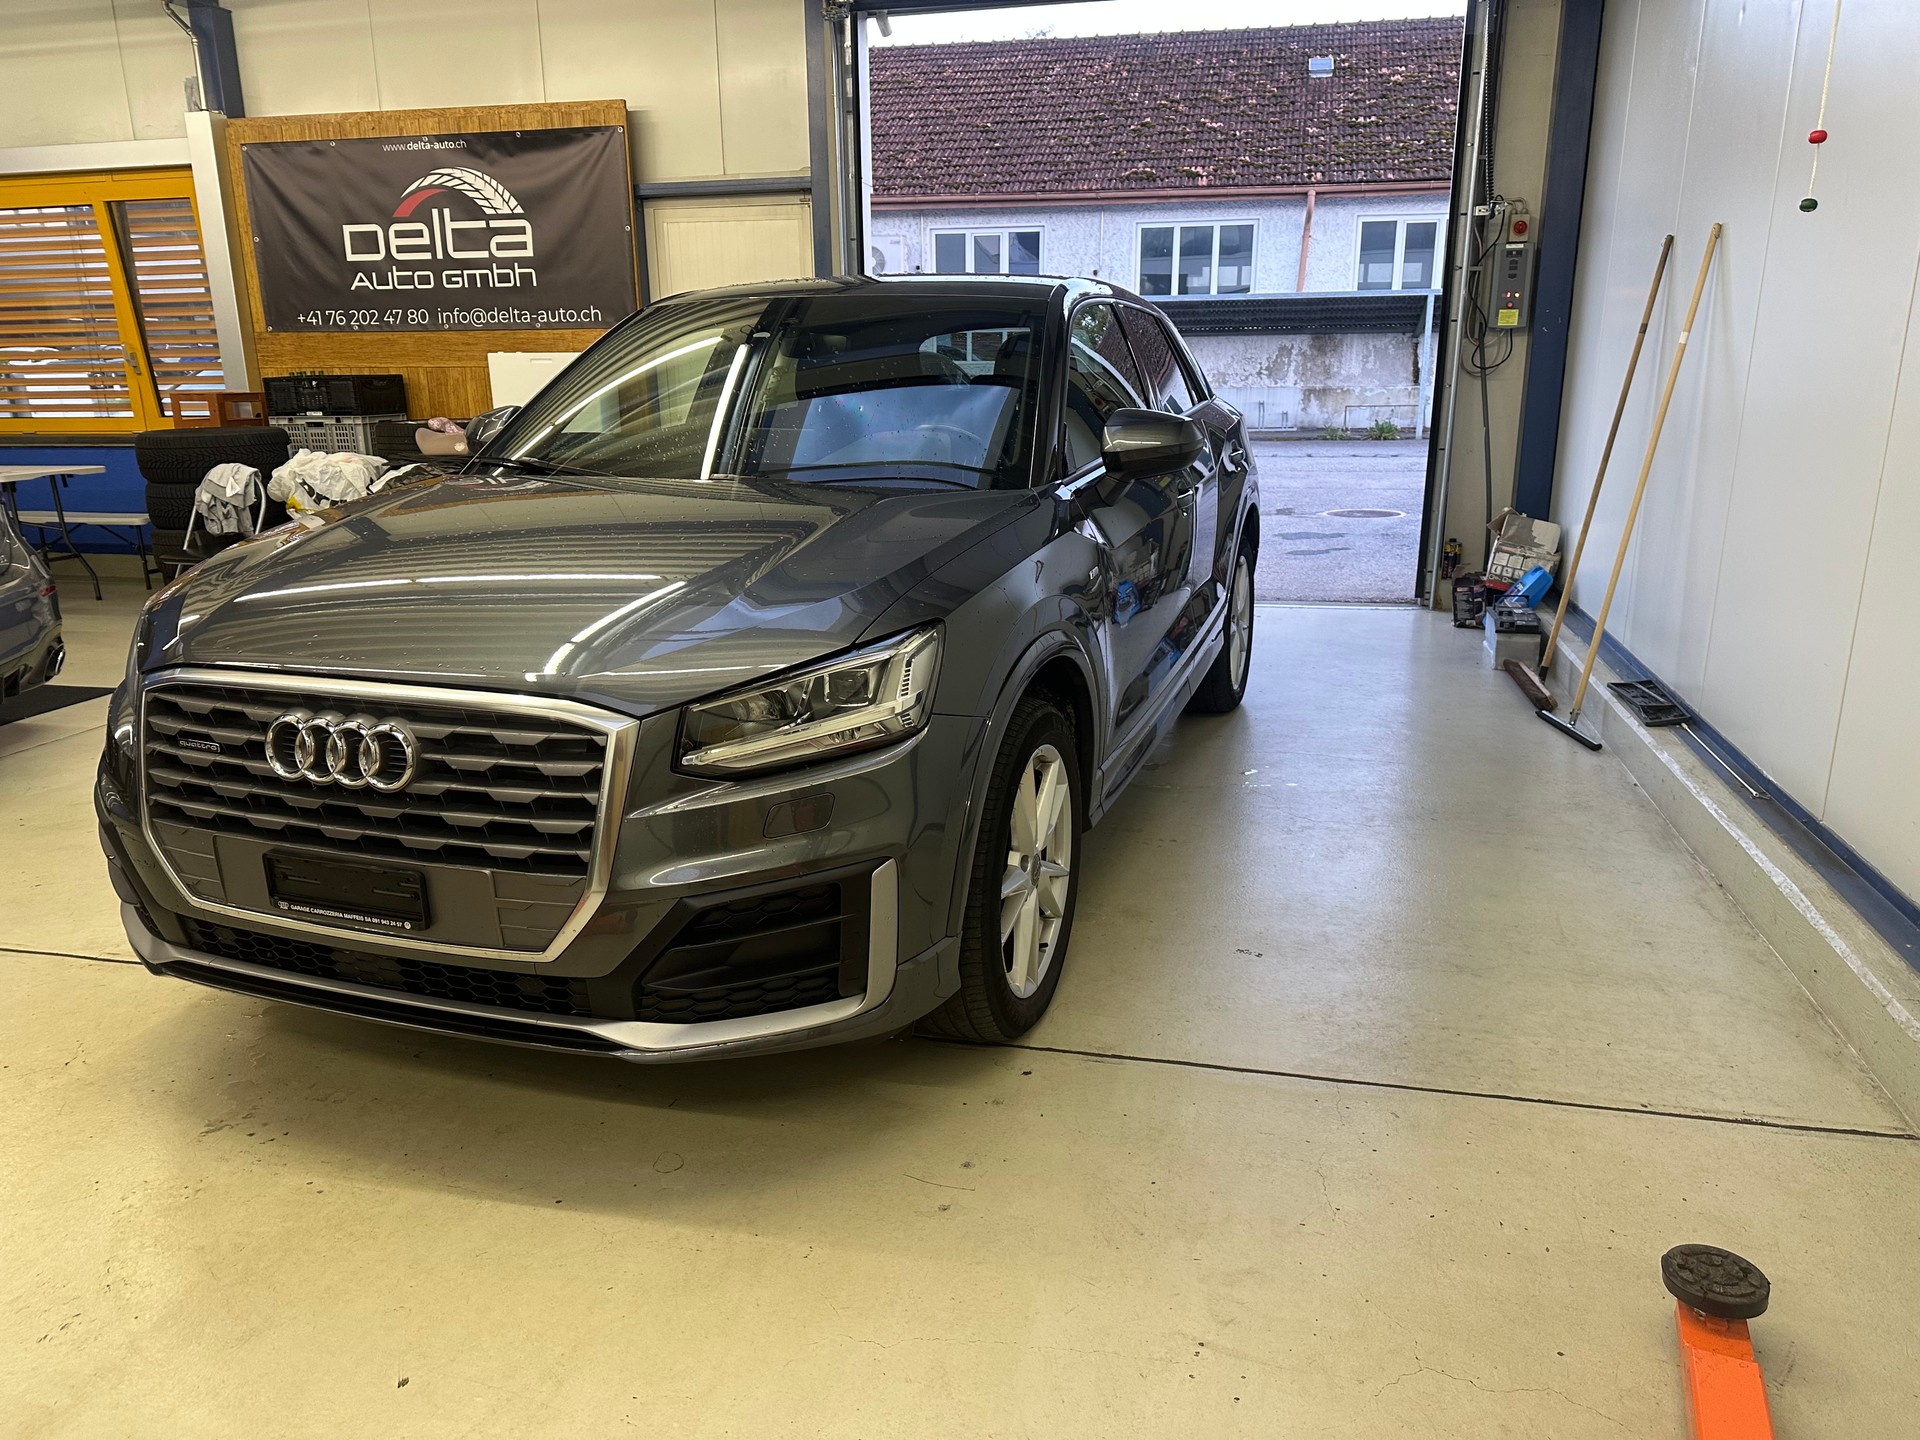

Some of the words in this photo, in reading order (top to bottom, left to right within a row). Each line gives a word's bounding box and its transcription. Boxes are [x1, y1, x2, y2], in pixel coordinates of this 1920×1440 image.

[382, 139, 467, 152] www.delta-auto.ch
[297, 310, 323, 325] +41
[325, 310, 346, 325] 76
[349, 309, 380, 325] 202
[383, 309, 402, 325] 47
[407, 308, 429, 325] 80
[437, 305, 602, 327] info@delta-auto.ch
[180, 740, 217, 751] quattro
[290, 904, 310, 913] GARAGE
[310, 907, 343, 918] CARROZZERIA
